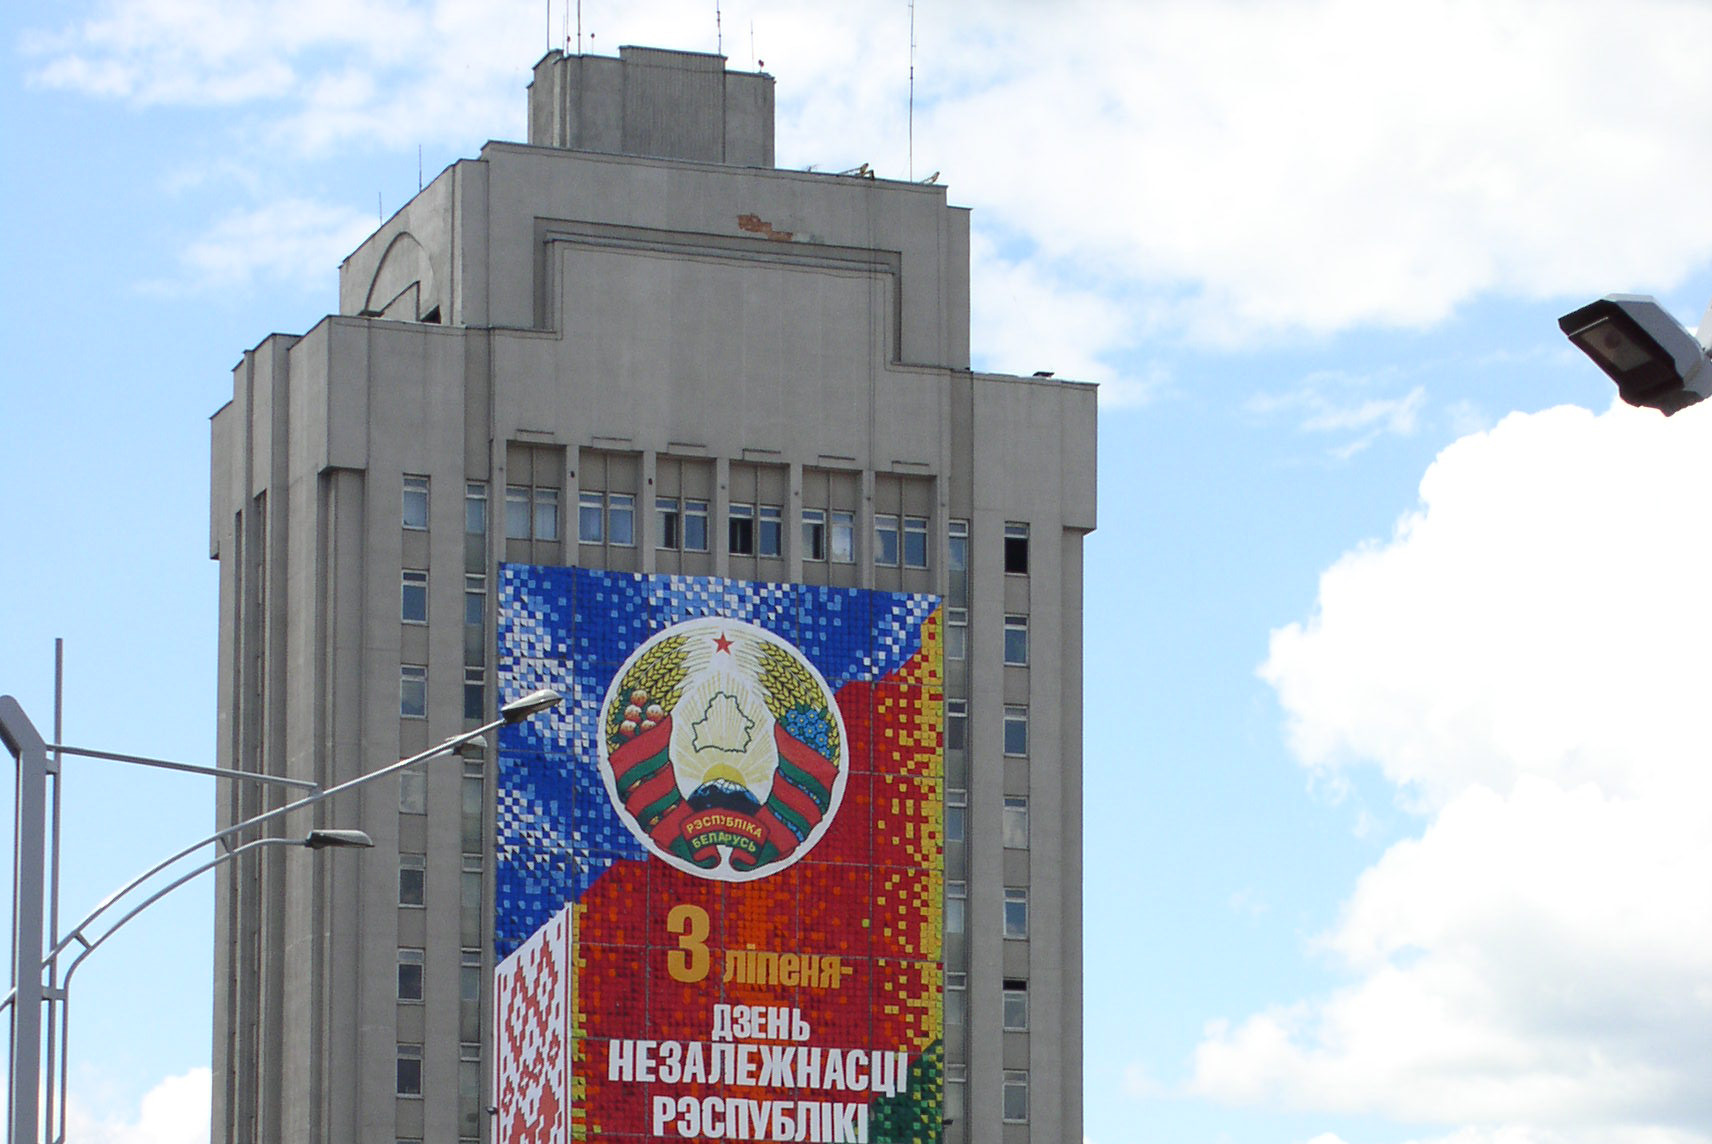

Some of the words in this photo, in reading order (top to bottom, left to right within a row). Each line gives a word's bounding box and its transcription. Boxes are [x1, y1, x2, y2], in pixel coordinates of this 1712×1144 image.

[686, 815, 762, 838] РЭСПУБЛІКА
[692, 831, 756, 852] БЕЛАРУСЬ
[667, 904, 710, 983] 3
[712, 1003, 810, 1042] ДЗЕНЬ
[608, 1039, 908, 1098] НЕЗАЛЕЖНАСЦІ
[653, 1095, 869, 1144] РЭСПУБЛІКІ
